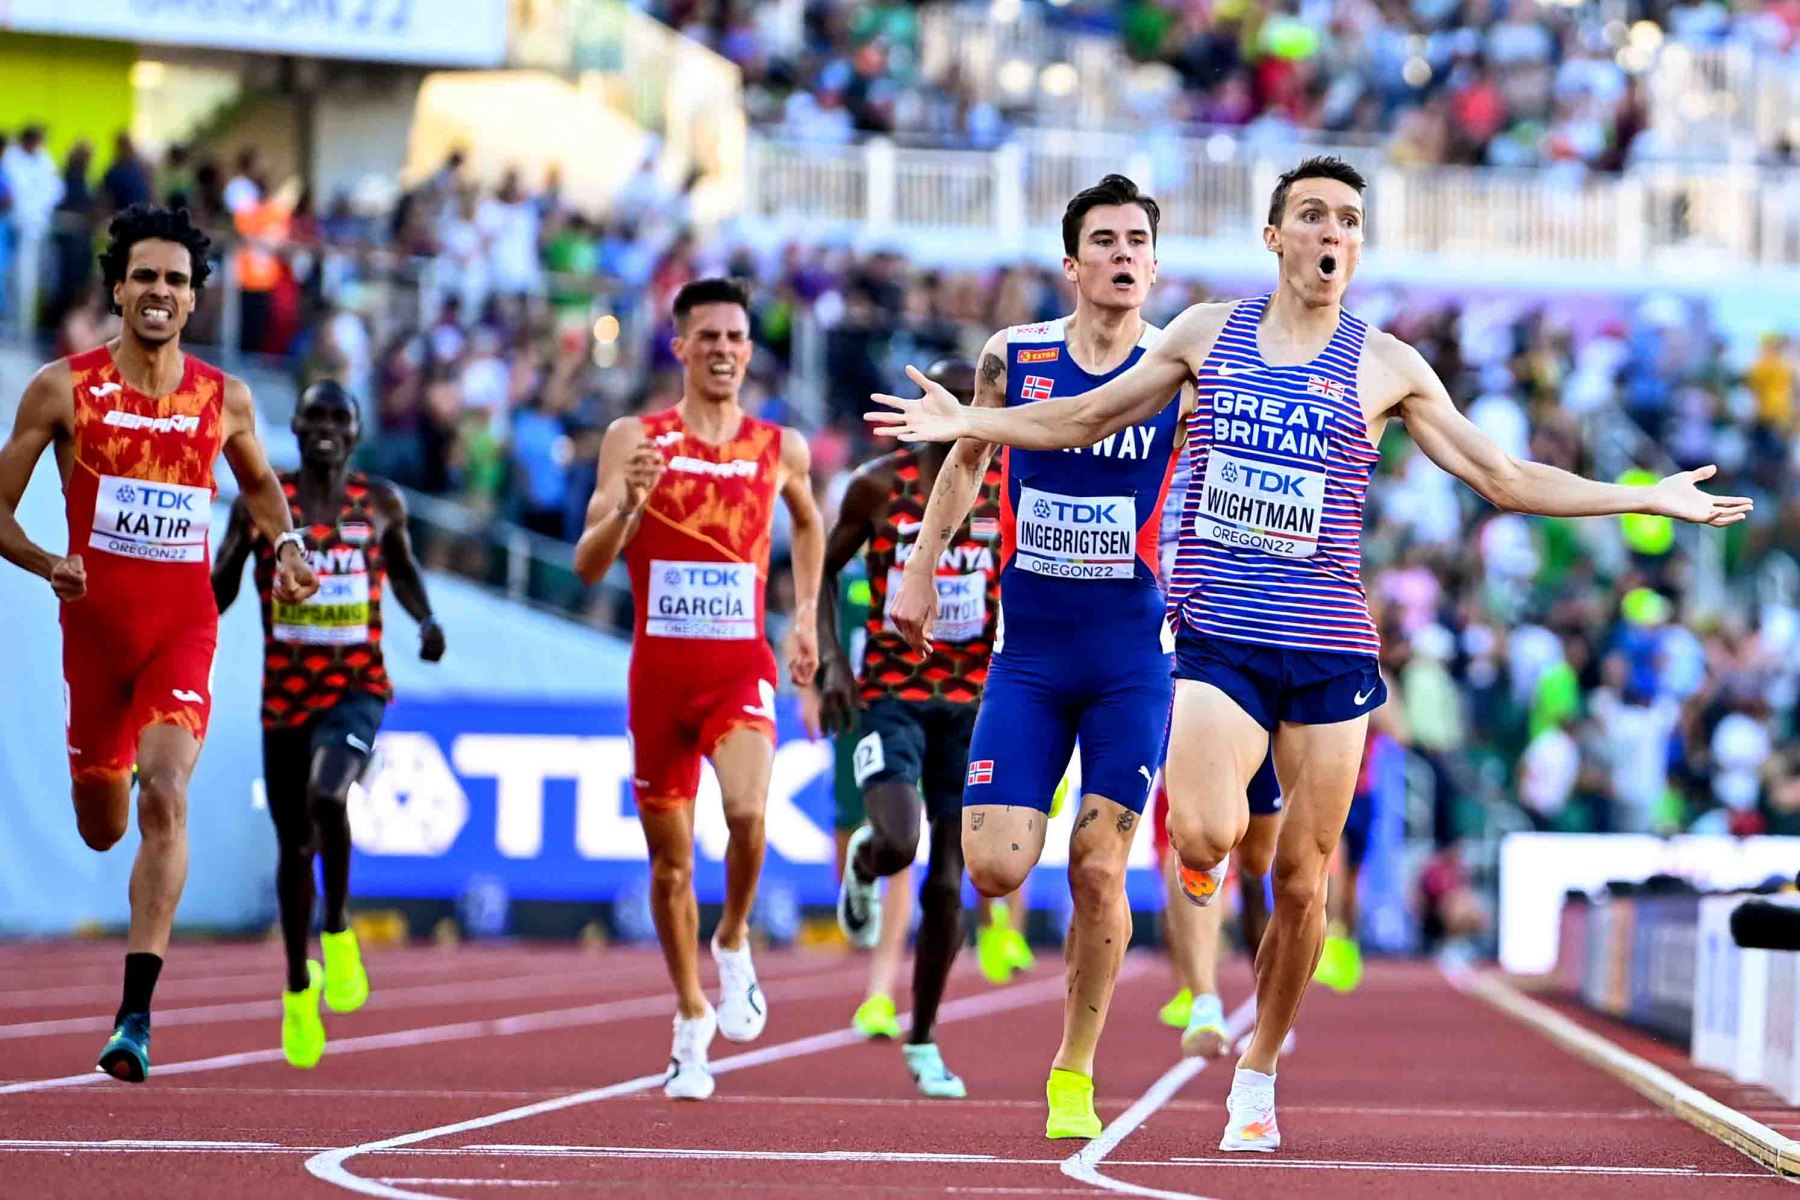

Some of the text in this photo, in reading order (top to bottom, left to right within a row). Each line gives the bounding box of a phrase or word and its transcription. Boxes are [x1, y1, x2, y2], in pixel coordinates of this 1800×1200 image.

[1213, 390, 1334, 432] GREAT
[1214, 417, 1328, 460] BRITAIN
[1239, 465, 1307, 498] TDK
[138, 487, 193, 511] TDK
[1051, 501, 1118, 524] TDK
[1207, 485, 1315, 534] WIGHTMAN
[115, 511, 191, 538] KATIR
[1021, 520, 1130, 555] INGEBRIGTSEN
[108, 539, 188, 560] OREGON22
[1212, 525, 1295, 554] OREGON22
[895, 542, 995, 571] KNYA
[1031, 559, 1114, 578] OREGON22
[683, 567, 741, 587] TDK
[658, 593, 744, 617] GARCÍA
[452, 733, 836, 864] TDK
